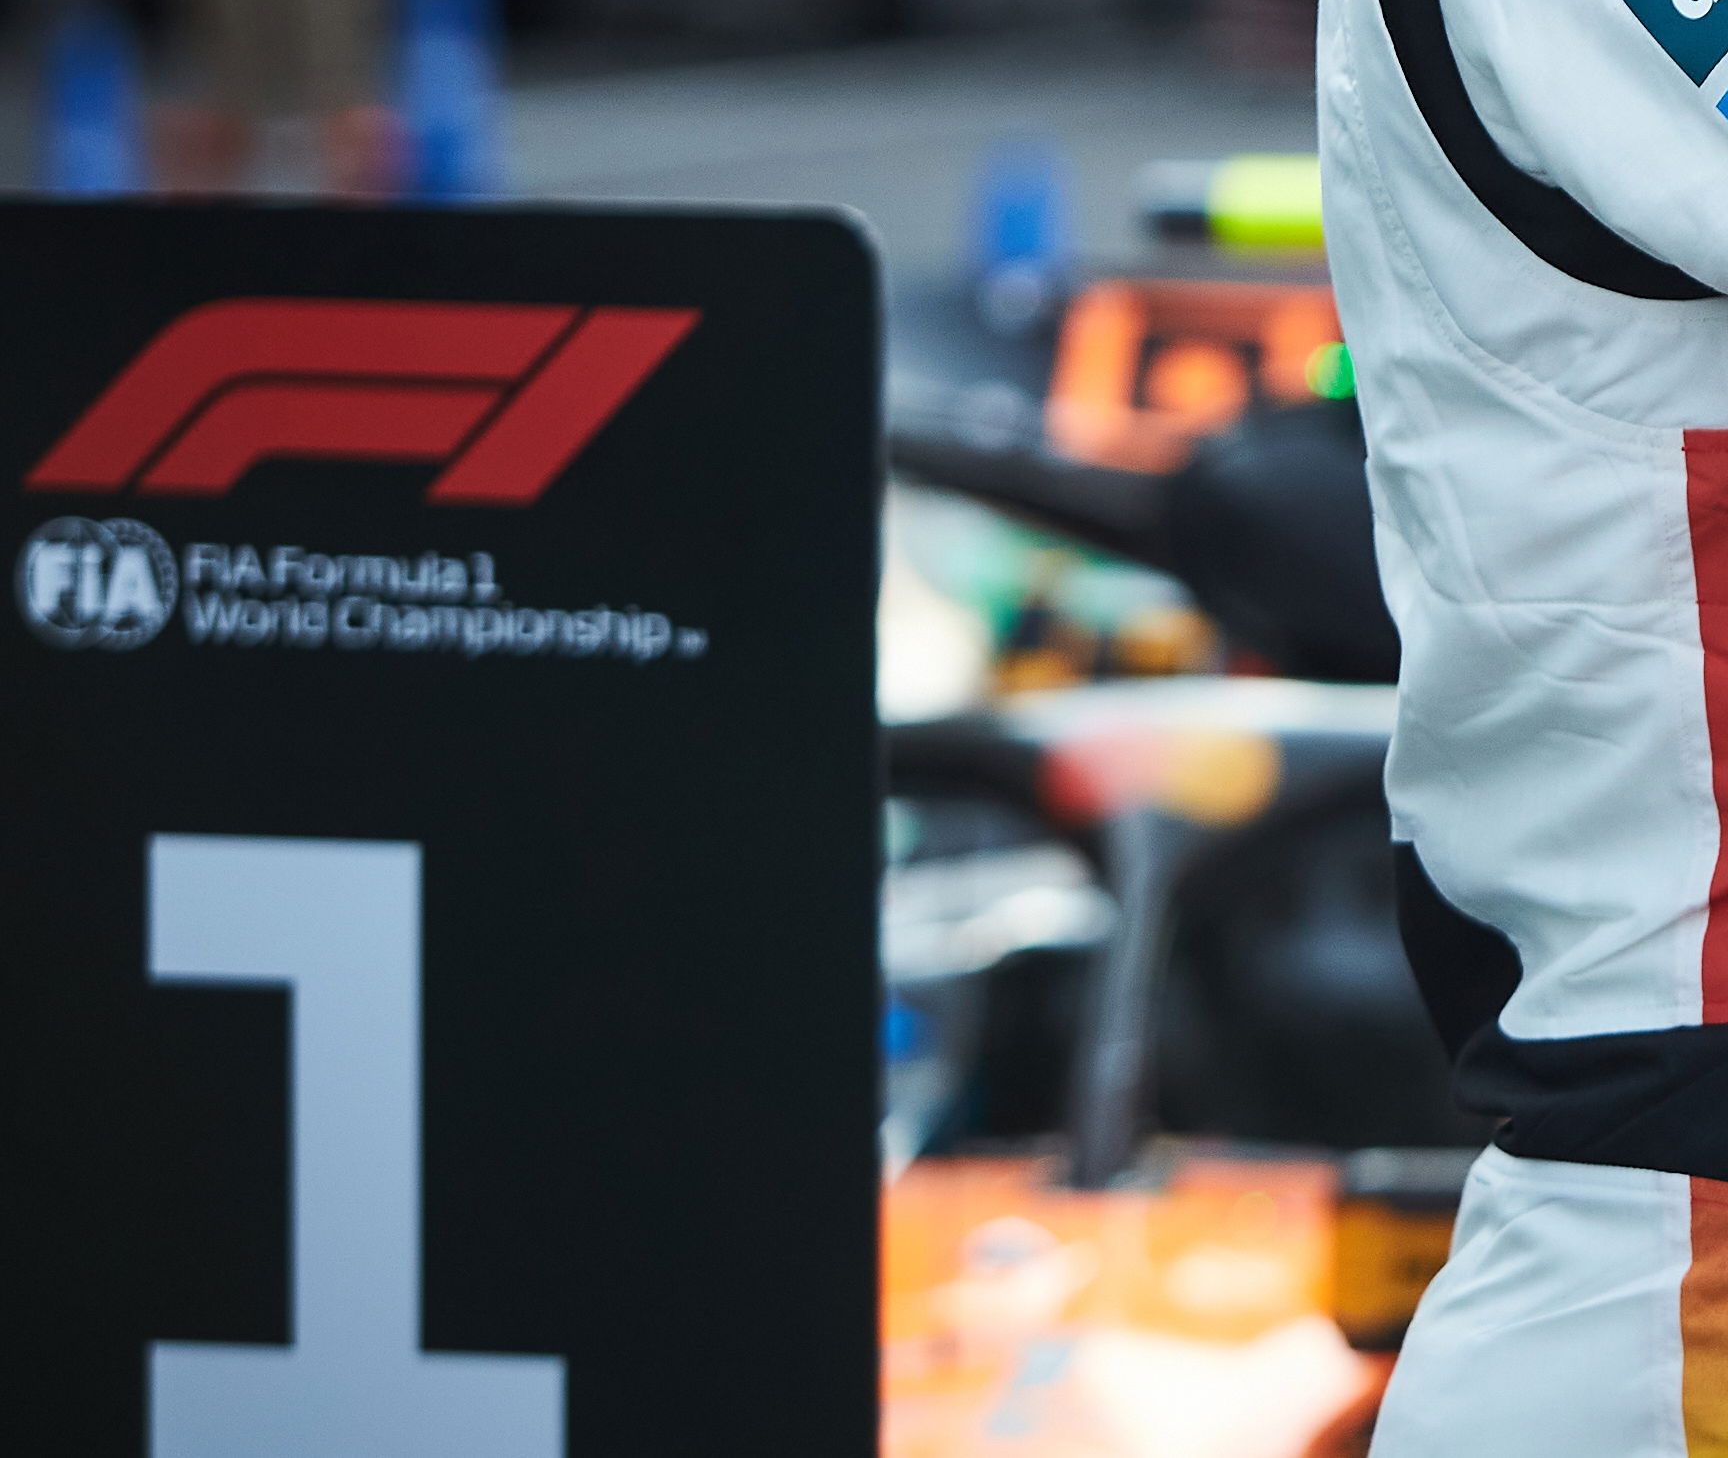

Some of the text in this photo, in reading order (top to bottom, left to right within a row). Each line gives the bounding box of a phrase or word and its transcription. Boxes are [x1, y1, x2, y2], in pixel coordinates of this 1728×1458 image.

[20, 296, 703, 505] F1
[184, 591, 332, 647] World
[334, 595, 673, 665] Championship
[186, 542, 502, 604] FIA Formula 1
[149, 834, 566, 1458] 1
